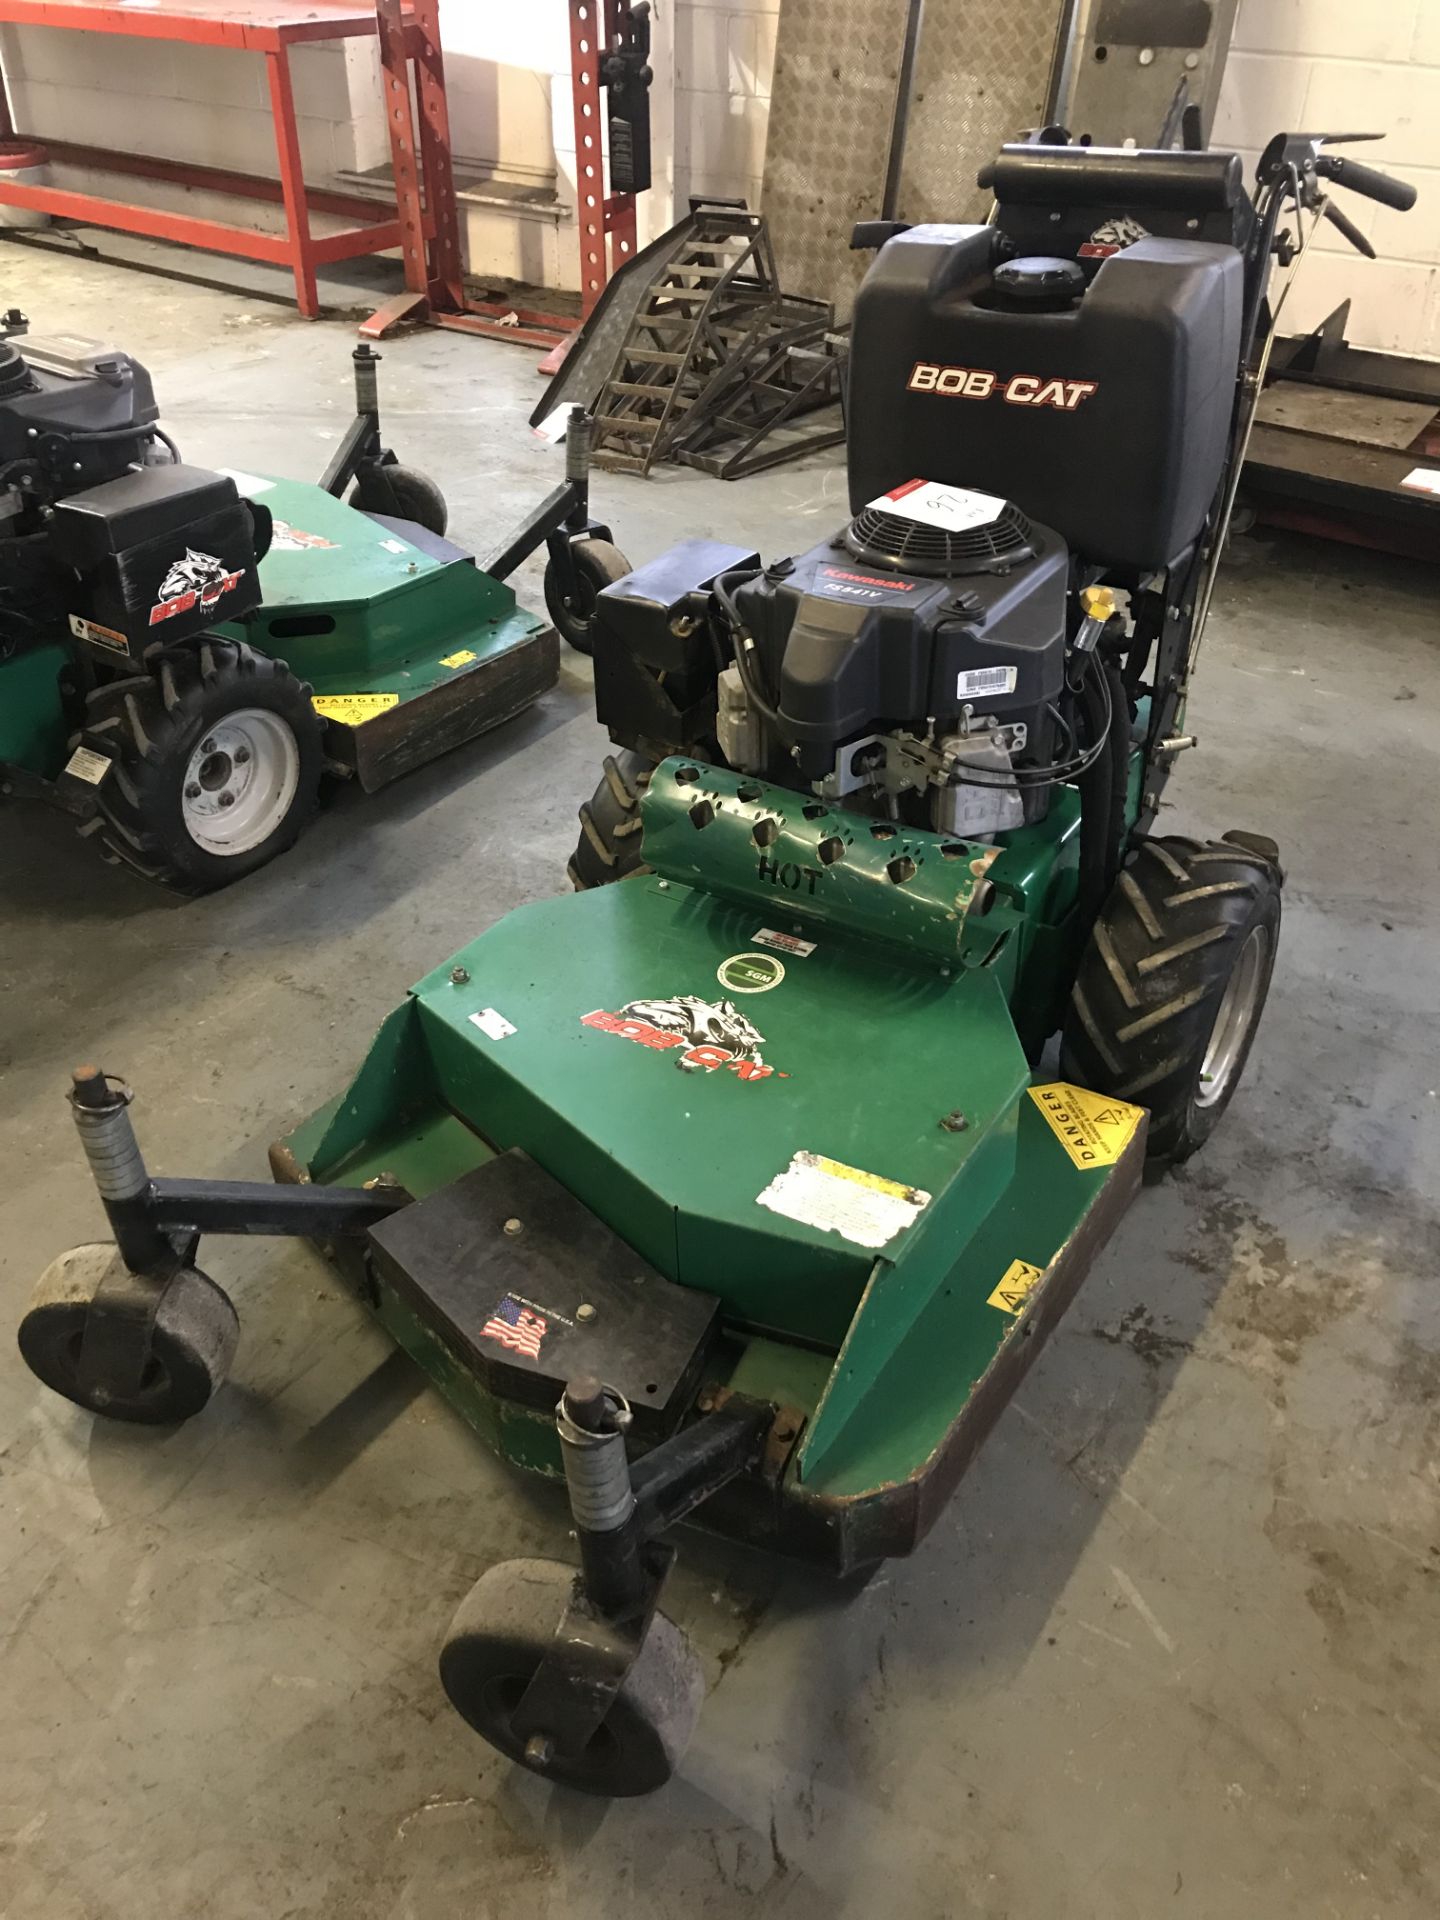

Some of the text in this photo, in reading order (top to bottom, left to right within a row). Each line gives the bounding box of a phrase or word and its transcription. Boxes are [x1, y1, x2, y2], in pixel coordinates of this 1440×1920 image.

[907, 364, 1097, 409] BOB-CAT
[823, 568, 916, 591] Kawasaki
[759, 855, 823, 895] HOT
[744, 970, 772, 983] SGM
[1041, 1091, 1096, 1161] DANGER
